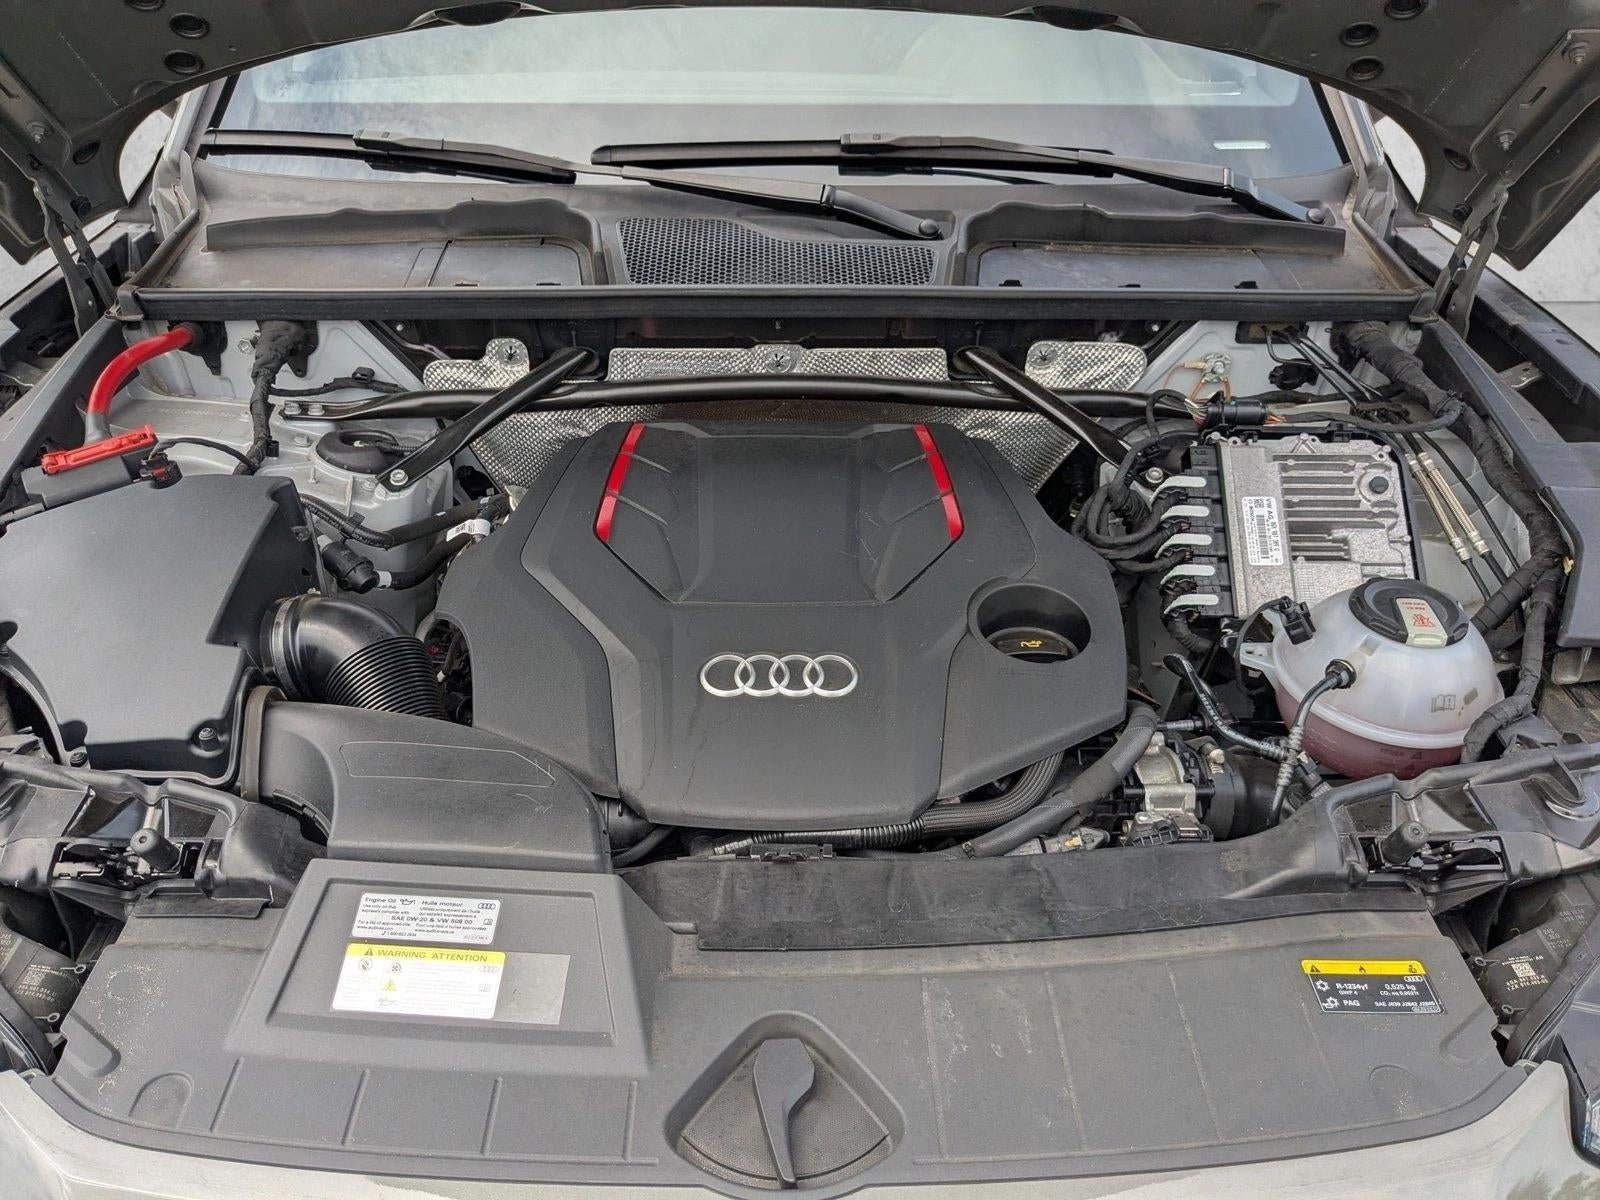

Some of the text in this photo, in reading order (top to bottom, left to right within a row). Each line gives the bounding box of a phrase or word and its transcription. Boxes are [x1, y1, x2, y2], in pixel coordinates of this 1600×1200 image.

[377, 950, 488, 962] WARNING ATTENTION
[1336, 983, 1368, 991] R-1234yf
